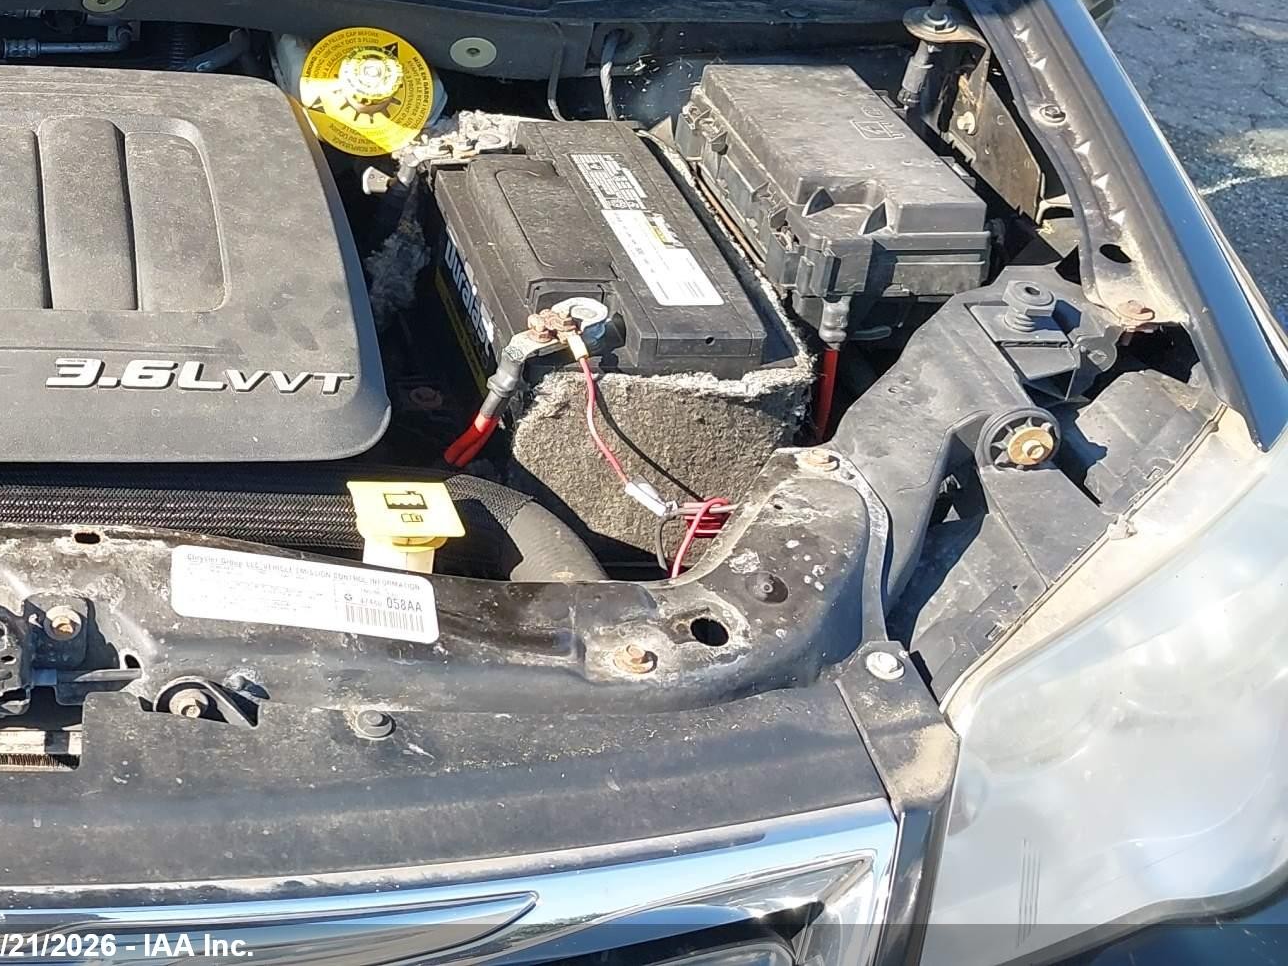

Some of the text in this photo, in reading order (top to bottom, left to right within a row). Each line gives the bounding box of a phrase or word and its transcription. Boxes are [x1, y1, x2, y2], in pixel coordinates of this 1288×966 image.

[314, 41, 329, 56] CLEAN
[344, 36, 356, 45] DOT
[411, 54, 425, 71] MISE
[420, 70, 428, 81] EN
[295, 567, 332, 580] EMISSION
[369, 577, 421, 592] INFORMATION
[386, 597, 423, 613] 058AA
